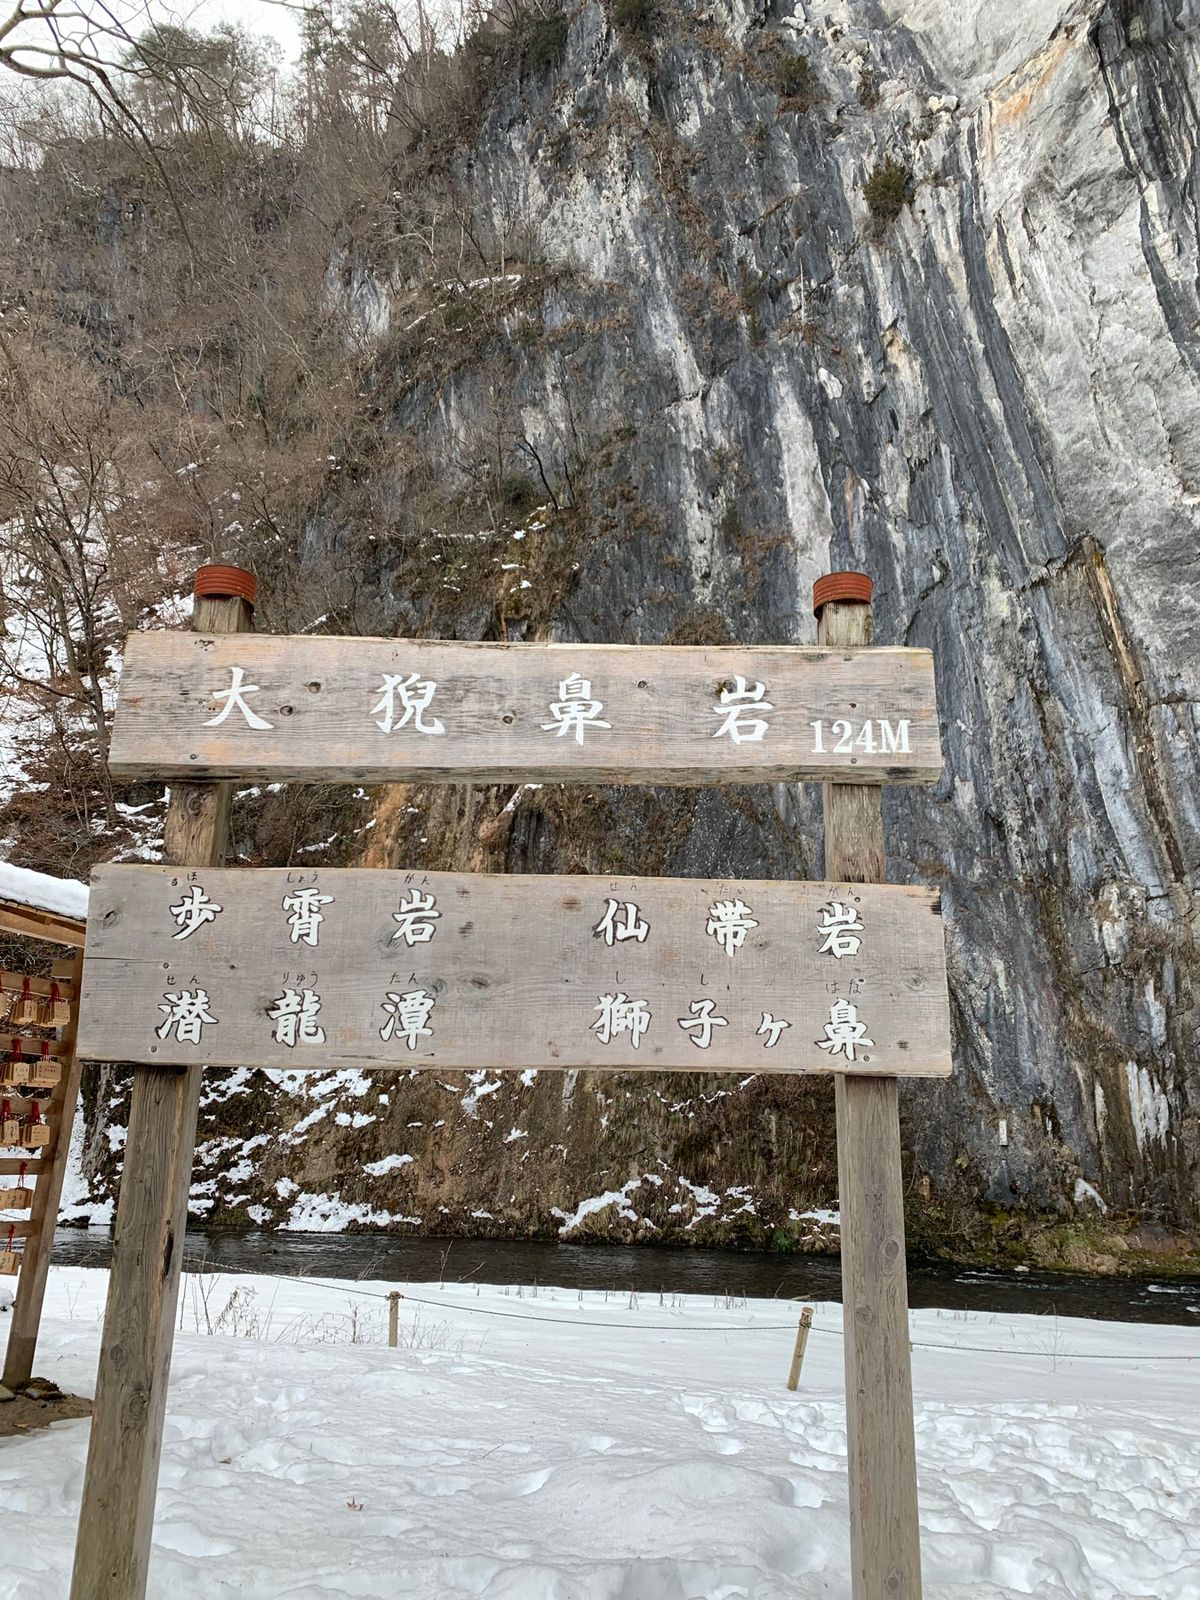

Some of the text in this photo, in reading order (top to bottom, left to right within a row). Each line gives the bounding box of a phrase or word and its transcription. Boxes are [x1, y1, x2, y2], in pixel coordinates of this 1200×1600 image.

[202, 667, 913, 754] 大猊鼻岩 124M
[169, 885, 443, 946] 歩霄岩
[594, 898, 865, 958] 仙帯岩
